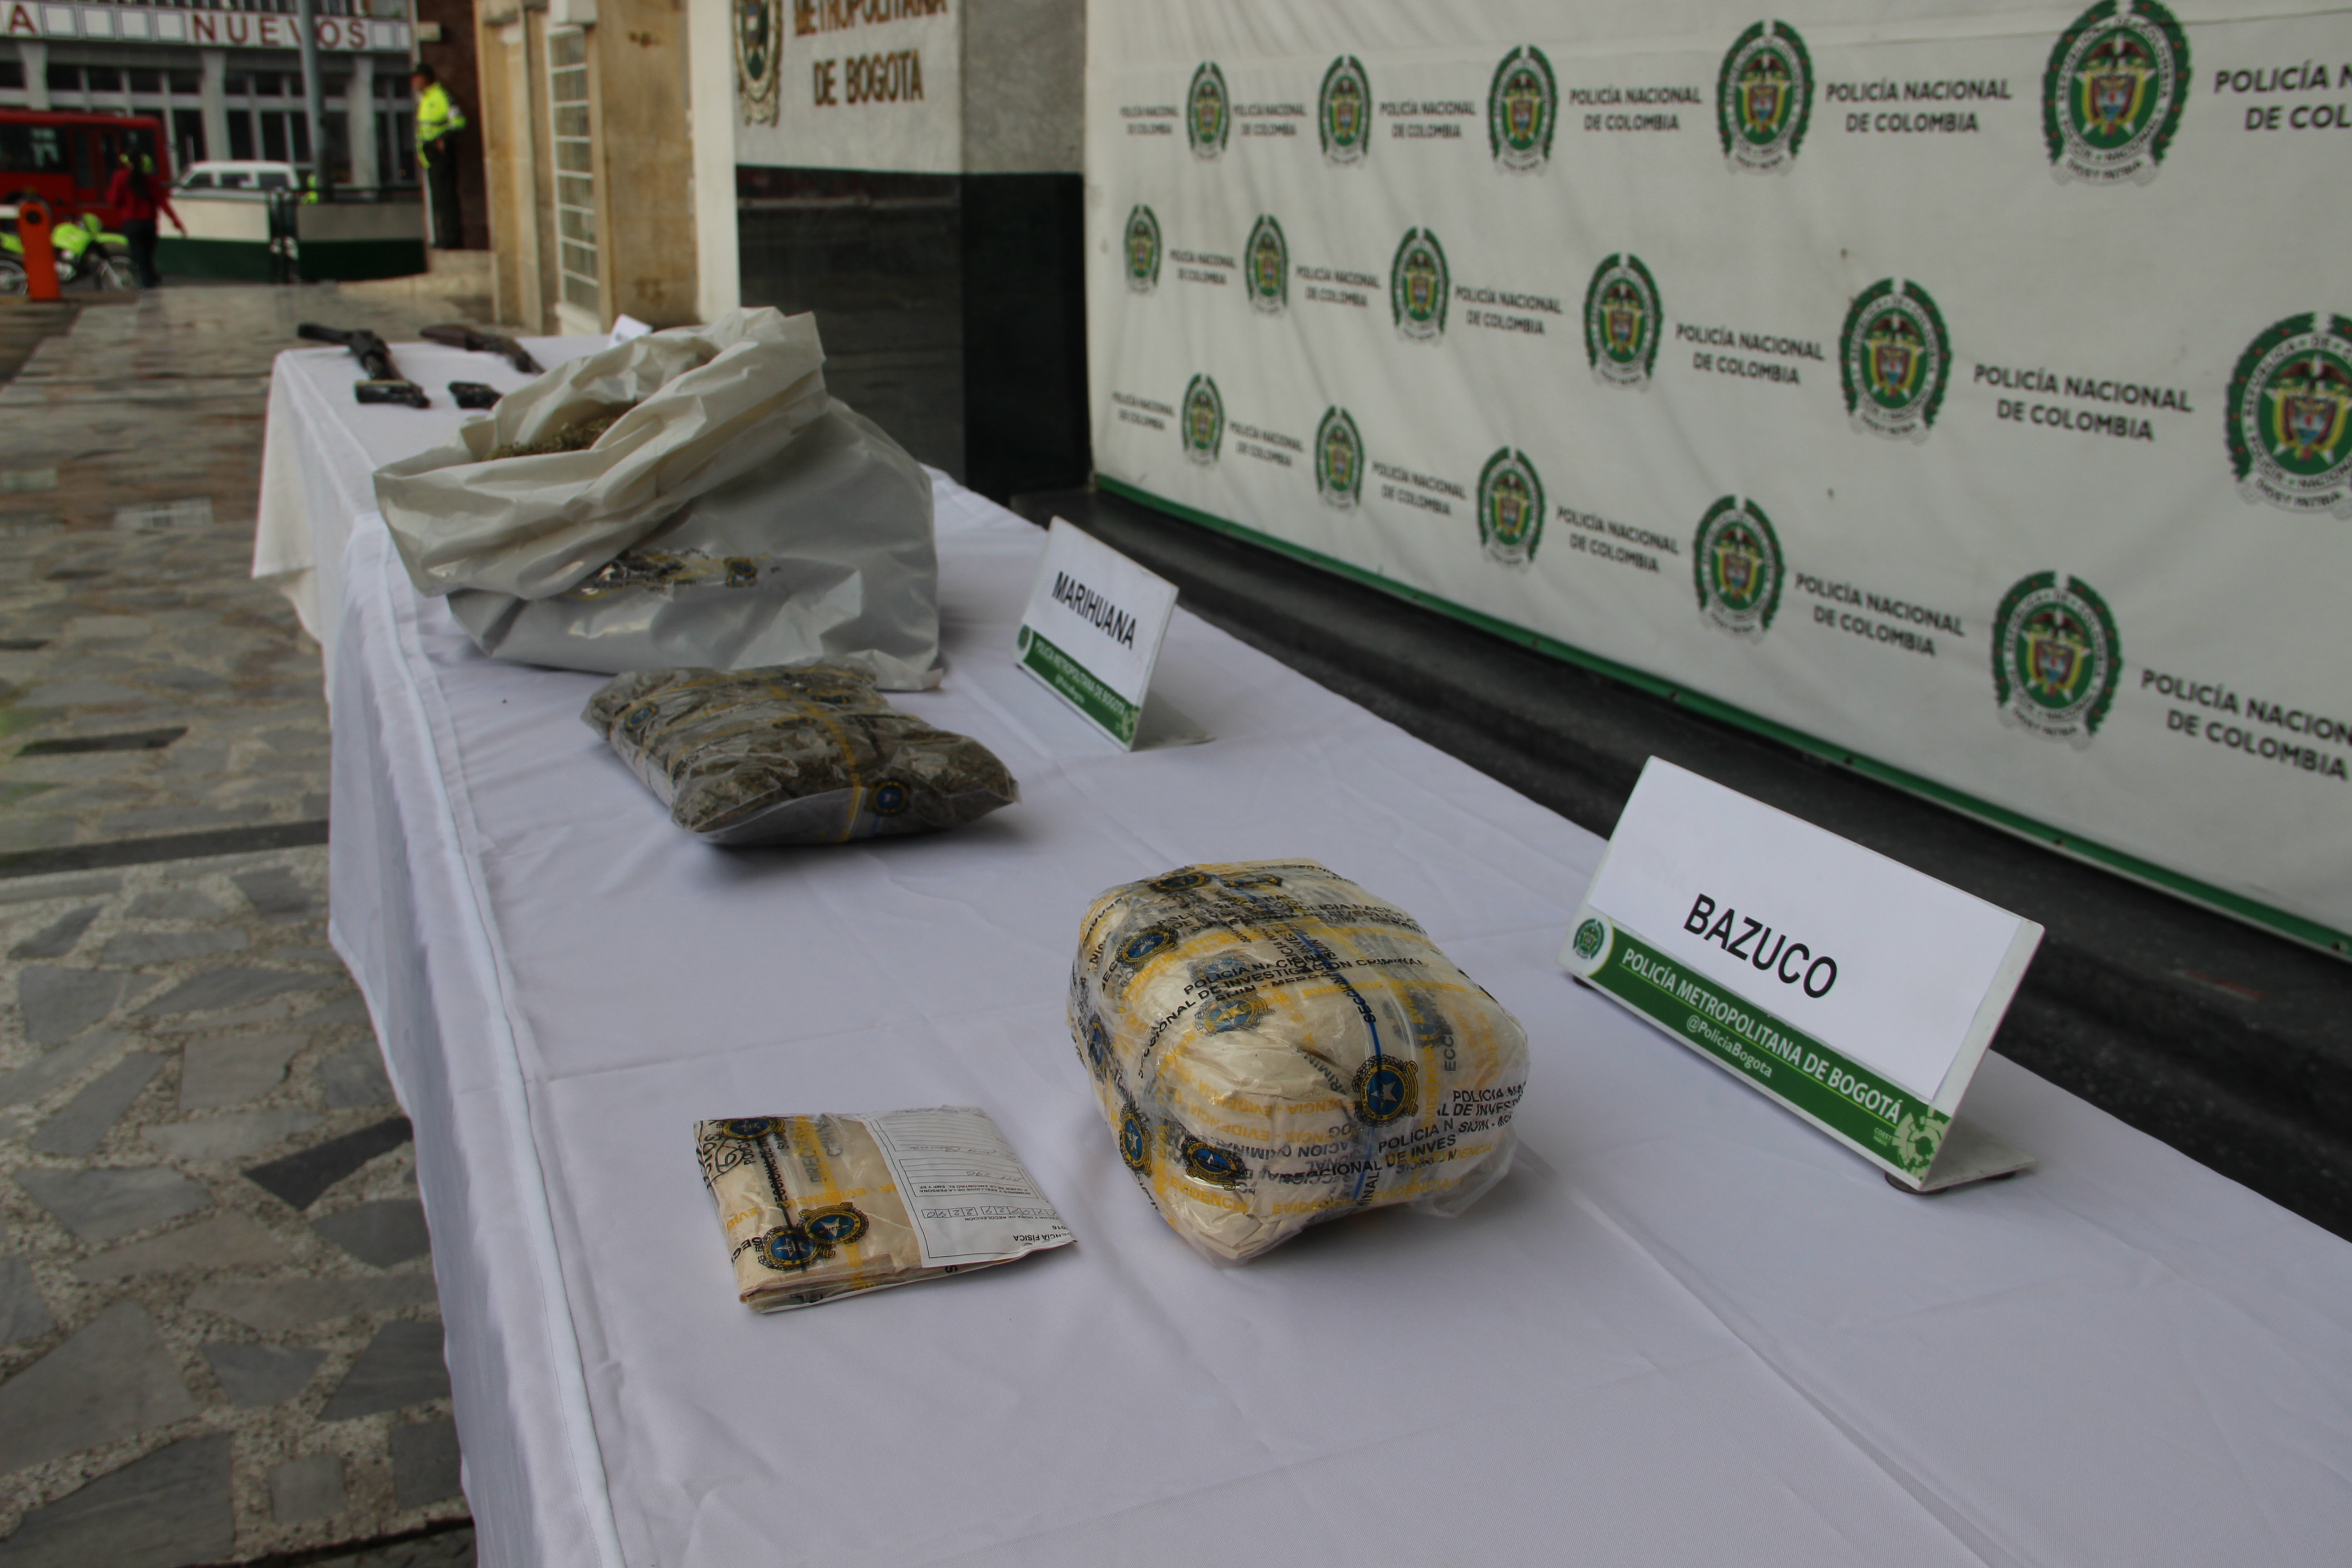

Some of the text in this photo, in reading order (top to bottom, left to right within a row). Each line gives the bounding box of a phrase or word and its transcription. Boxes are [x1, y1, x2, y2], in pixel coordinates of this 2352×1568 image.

[814, 59, 837, 106] DE
[1826, 77, 2012, 102] POLICÍA NACIONAL
[2214, 59, 2352, 94] POLICÍA N
[1421, 101, 1476, 117] NACIONAL
[1569, 84, 1702, 105] POLICÍA NACIONAL
[1392, 124, 1462, 138] DE COLOMBIA
[1583, 114, 1680, 131] DE COLOMBIA
[1846, 112, 1979, 132] DE COLOMBIA
[2244, 103, 2352, 131] DE COL
[1334, 270, 1382, 289] NACIONAL
[1305, 286, 1368, 308] DE COLOMBIA
[1455, 284, 1563, 315] POLICÍA NACIONAL
[1467, 309, 1546, 336] DE COLOMBIA
[1676, 323, 1825, 361] POLICÍA NACIONAL
[1692, 352, 1802, 386] DE COLOMBIA
[1973, 363, 2195, 413] POLICÍA NACIONAL
[1997, 398, 2156, 441] DE COLOMBIA
[1236, 441, 1293, 467] DE COLOMBIA
[1262, 429, 1304, 452] NACIONAL
[1372, 460, 1467, 500] POLICÍA NACIONAL
[1381, 484, 1451, 517] DE COLOMBIA
[1556, 505, 1681, 555] POLICÍA NACIONAL
[1569, 533, 1659, 573] DE COLOMBIA
[1051, 570, 1137, 651] MARIHUANA
[1795, 572, 1965, 636] POLICÍA NACIONAL
[1813, 604, 1936, 657] DE COLOMBIA
[2141, 667, 2352, 747] POLICÍA NACION
[2166, 709, 2349, 782] DE COLOMBIA
[1682, 893, 1838, 999] BAZUCO
[1183, 963, 1251, 995] POLICIA
[1197, 986, 1220, 1001] DE
[1622, 948, 1904, 1124] POLICÍA METROPOLITANA DE BOGOTÁ
[1686, 1014, 1773, 1078] @PoliciaBogota
[1453, 1088, 1504, 1102] POLICIA
[1453, 1103, 1474, 1116] DE
[1378, 1123, 1440, 1154] POLICIA
[1458, 1119, 1490, 1133] SIJIN
[1385, 1150, 1406, 1168] DE
[1410, 1134, 1456, 1157] INVES
[1170, 1175, 1249, 1214] EVIDENCIA
[1013, 1234, 1040, 1242] FÍSICA
